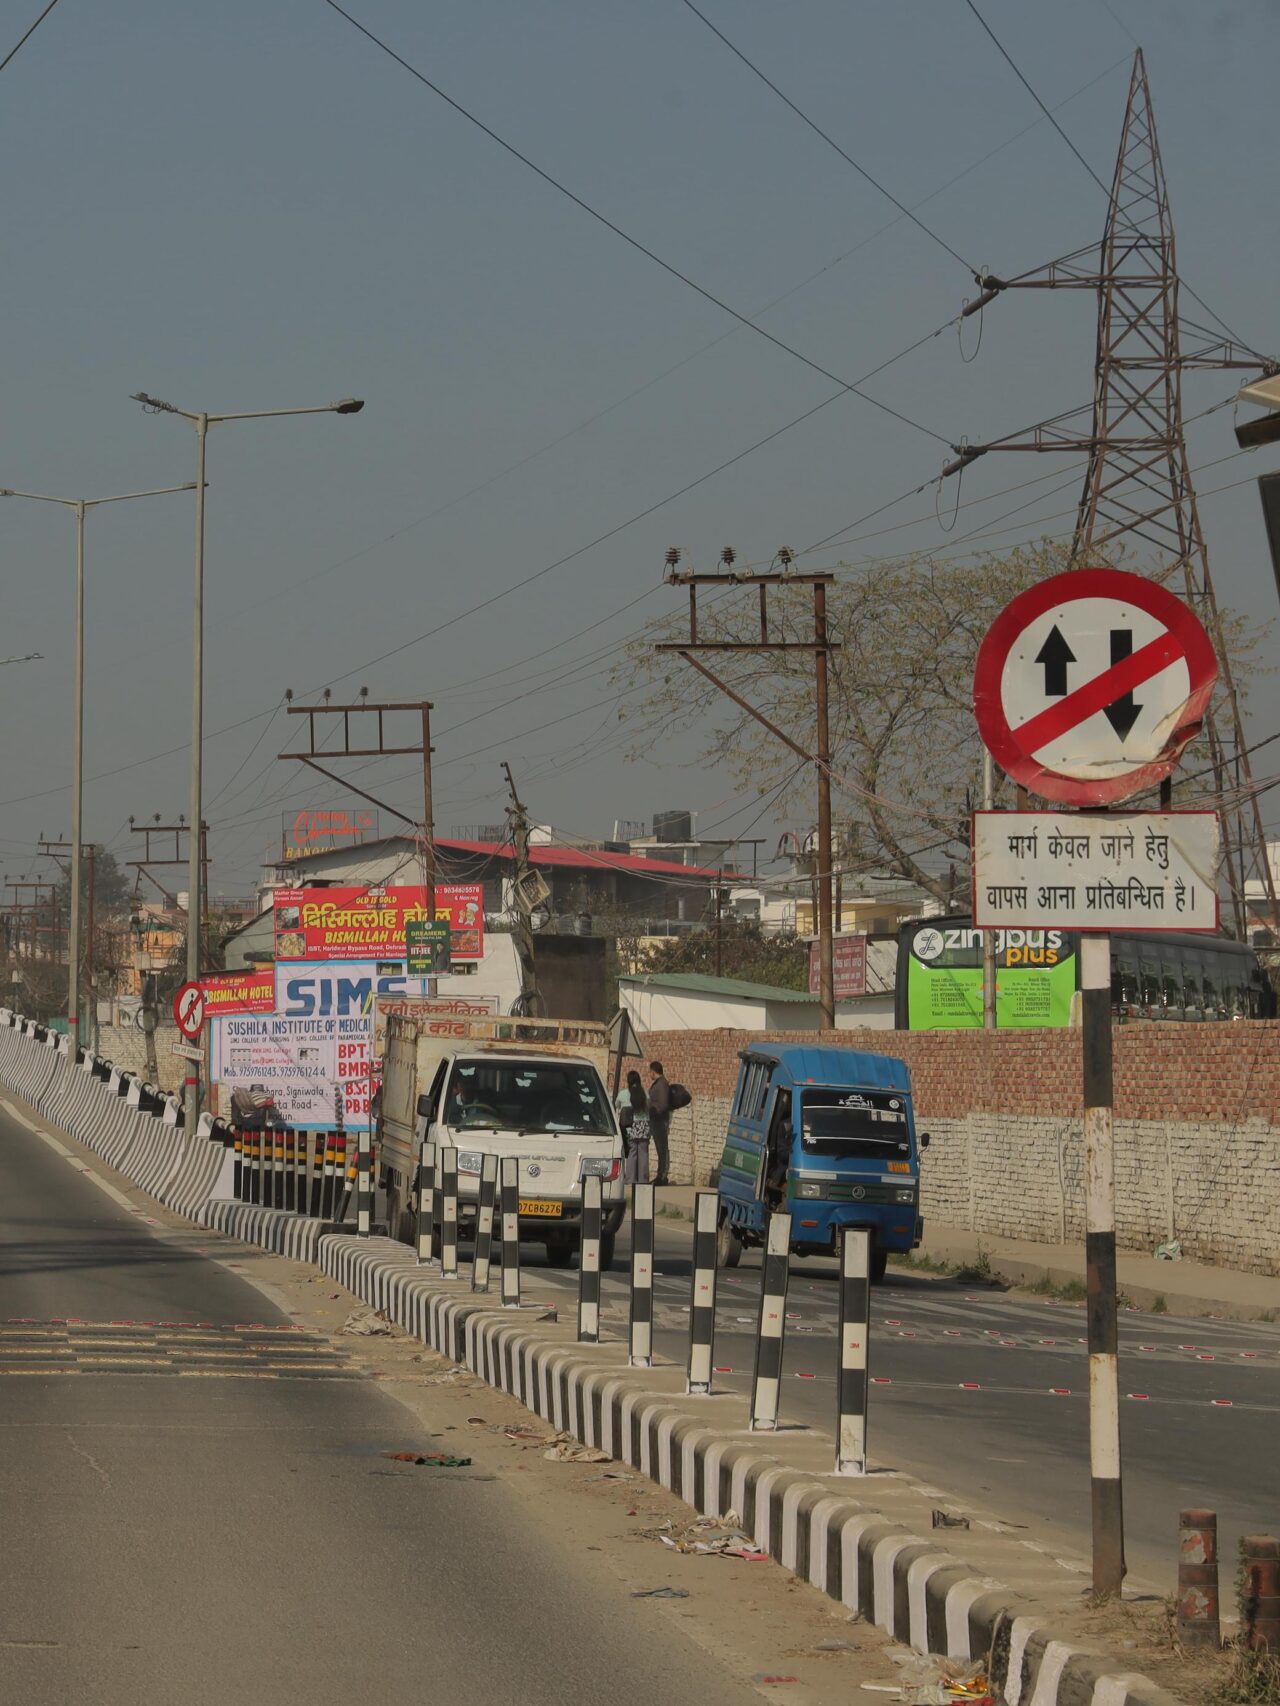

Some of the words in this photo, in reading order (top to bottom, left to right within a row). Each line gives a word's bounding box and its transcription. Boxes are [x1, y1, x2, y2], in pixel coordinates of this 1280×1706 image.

[1008, 826, 1038, 859] मार्ग
[1047, 825, 1090, 859] केवल
[1100, 826, 1135, 859] जाने
[1145, 826, 1170, 870] हेतु
[986, 886, 1028, 910] वापस
[1037, 886, 1076, 910] आना
[1086, 876, 1165, 910] प्रतिबन्धित
[325, 930, 388, 944] BISMILLAH
[411, 947, 431, 955] IIT-JEE
[1006, 944, 1058, 967] plus
[209, 988, 248, 1004] BISMILLAH
[250, 986, 273, 1000] HOTEL
[227, 1022, 268, 1035] SUSHILA
[272, 1020, 323, 1034] INSTITUTE
[325, 1020, 335, 1033] OF
[338, 1043, 367, 1058] BPT
[519, 1203, 561, 1213] 07CB6276
